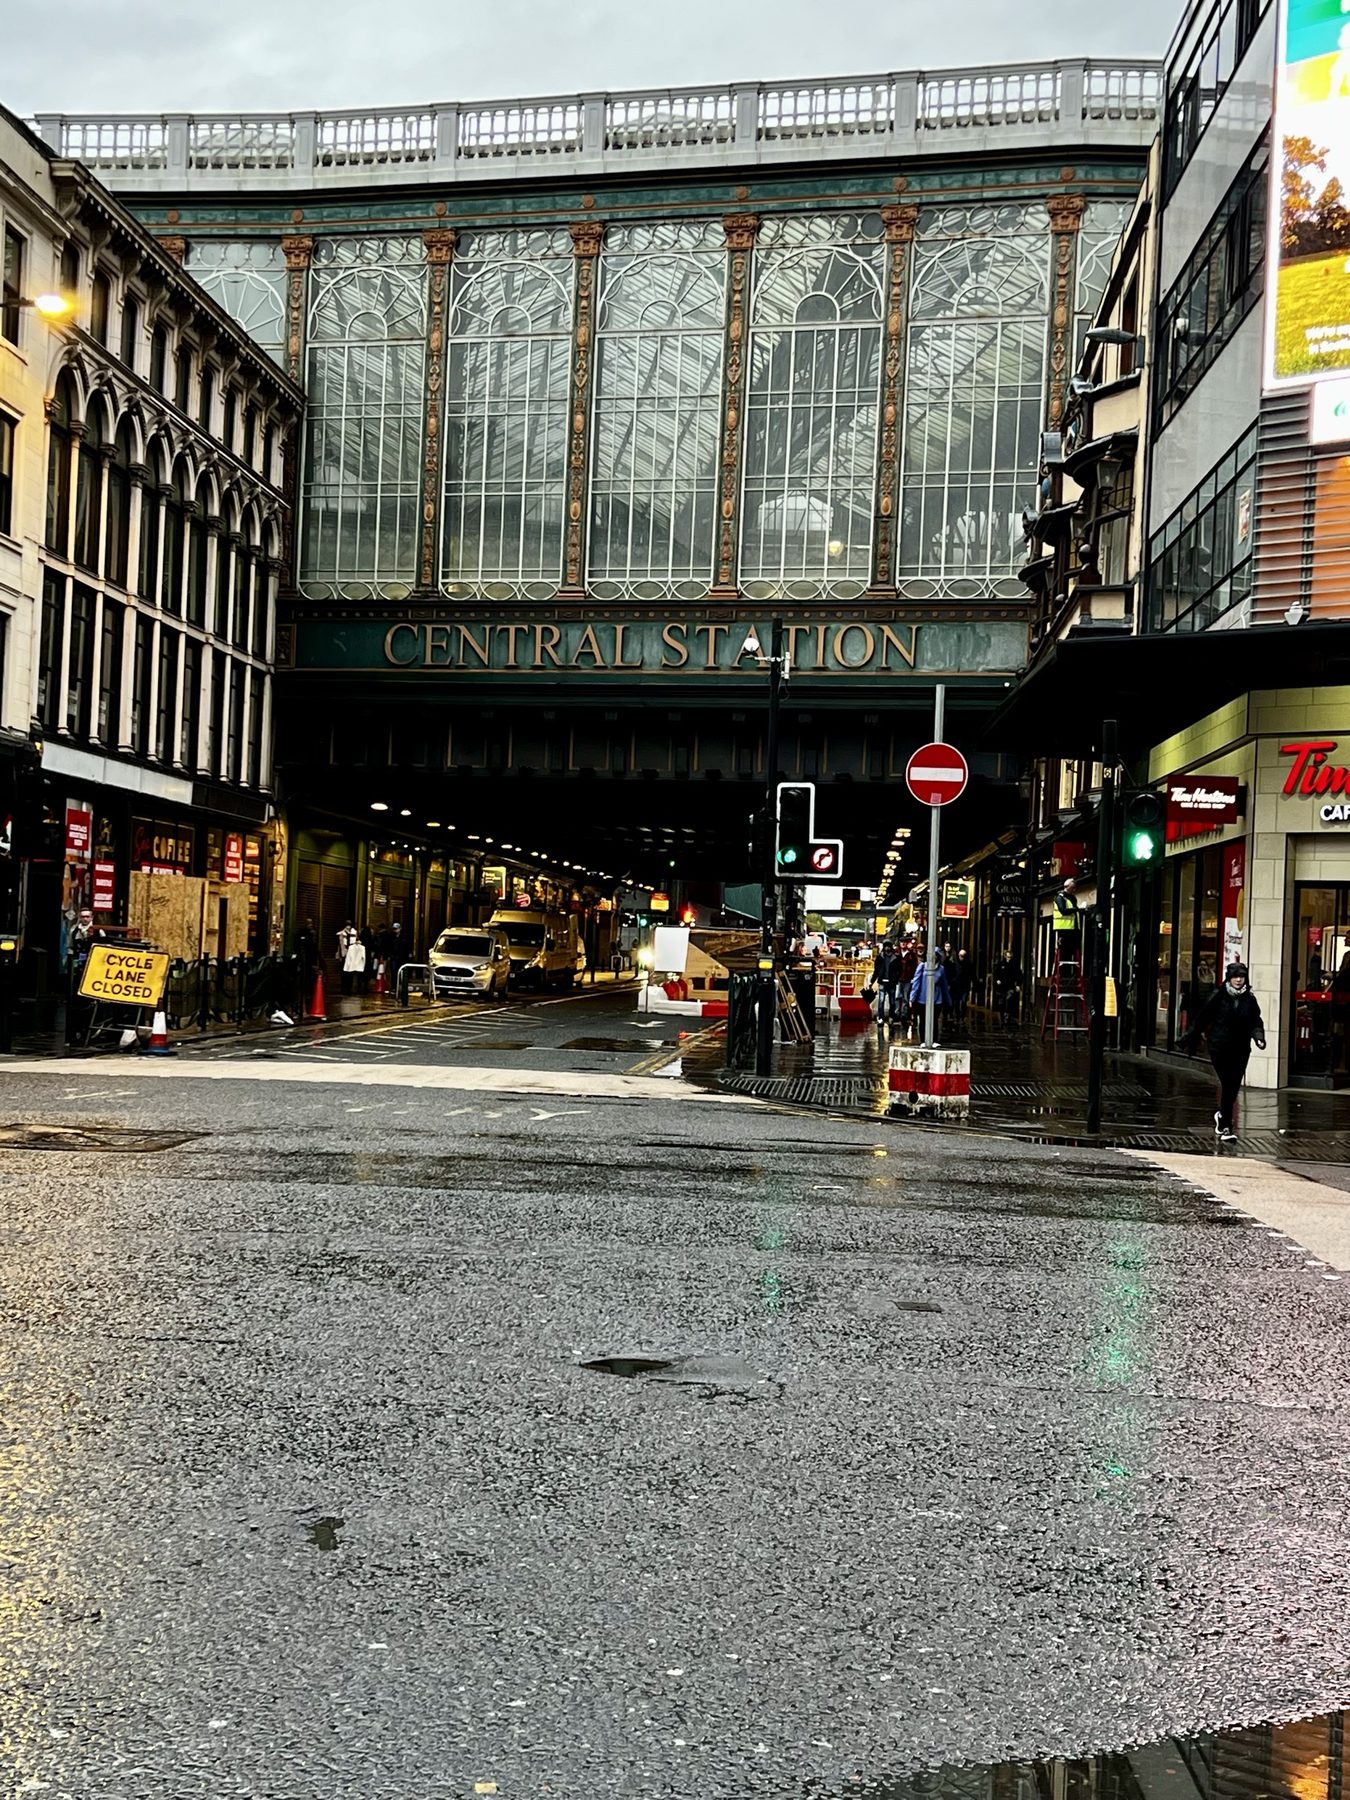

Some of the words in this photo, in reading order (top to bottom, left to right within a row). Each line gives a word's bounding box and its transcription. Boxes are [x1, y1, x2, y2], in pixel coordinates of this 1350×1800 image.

[383, 622, 643, 669] CENTRAL
[661, 622, 920, 670] STATION
[1279, 740, 1350, 796] Tim
[1170, 787, 1192, 802] Tim
[1192, 787, 1236, 804] Hortons
[995, 884, 1026, 894] GRANT
[106, 954, 154, 970] CYCLE
[105, 968, 146, 983] LANE
[91, 980, 152, 998] CLOSED
